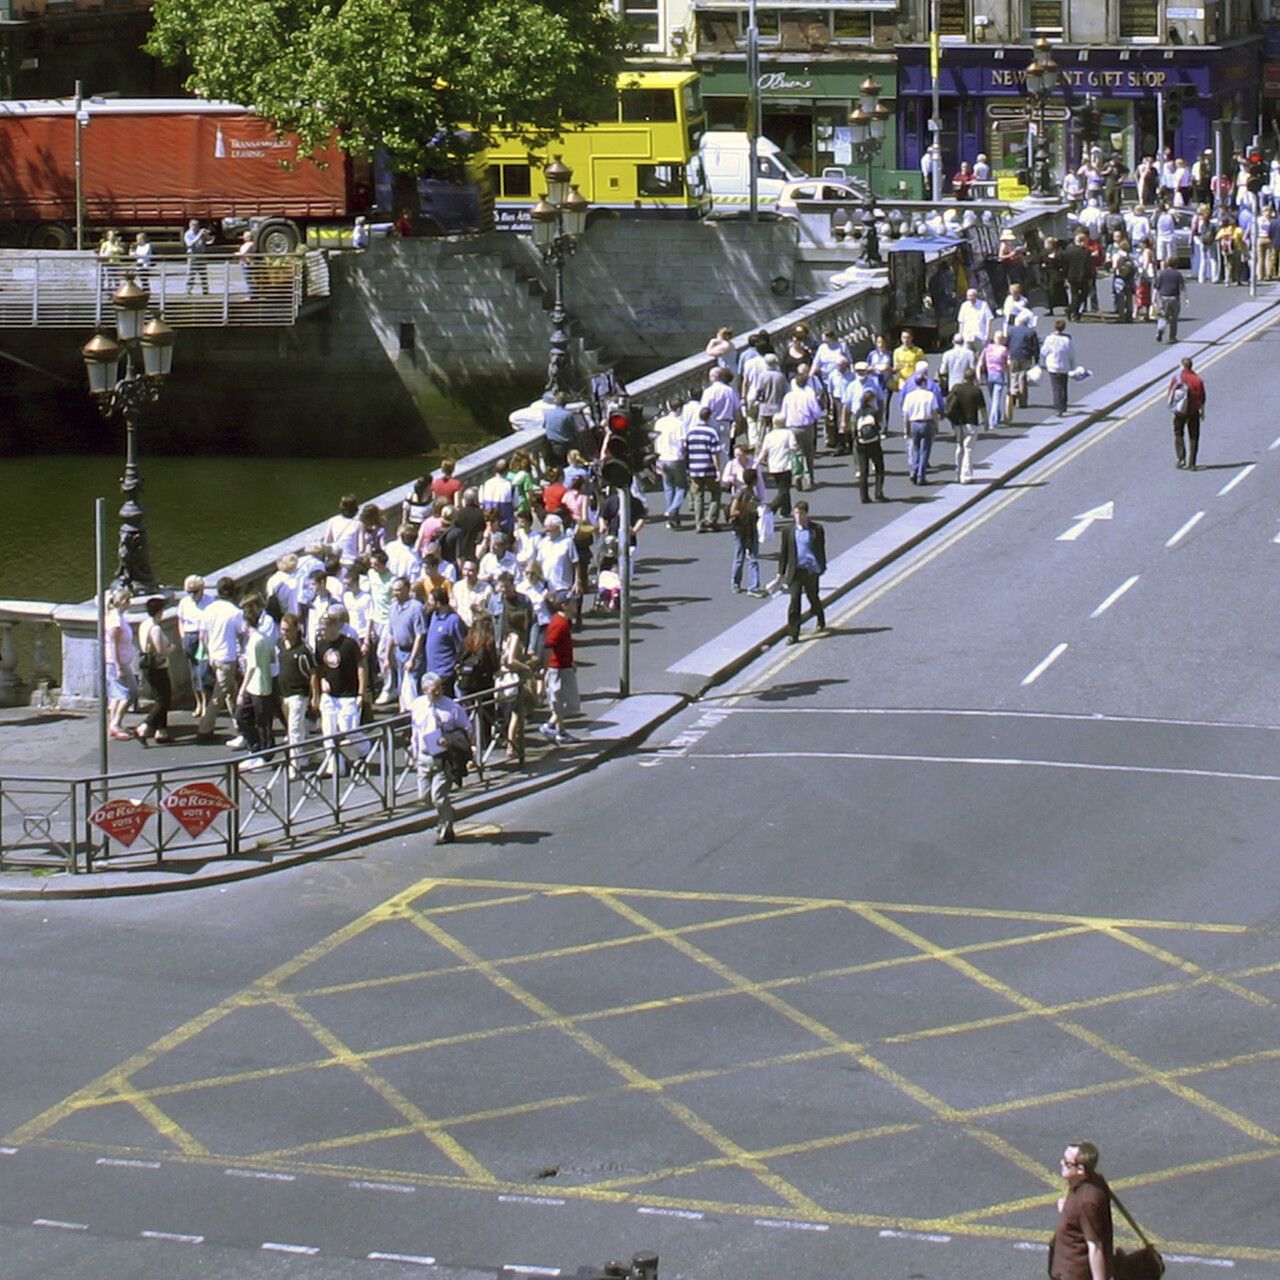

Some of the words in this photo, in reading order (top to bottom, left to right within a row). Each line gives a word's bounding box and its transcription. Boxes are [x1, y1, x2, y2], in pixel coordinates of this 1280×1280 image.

[1088, 70, 1124, 86] GIFT
[1127, 71, 1167, 87] SHOP
[183, 809, 203, 817] VOTE
[205, 809, 211, 818] 1
[111, 816, 133, 827] VOTE
